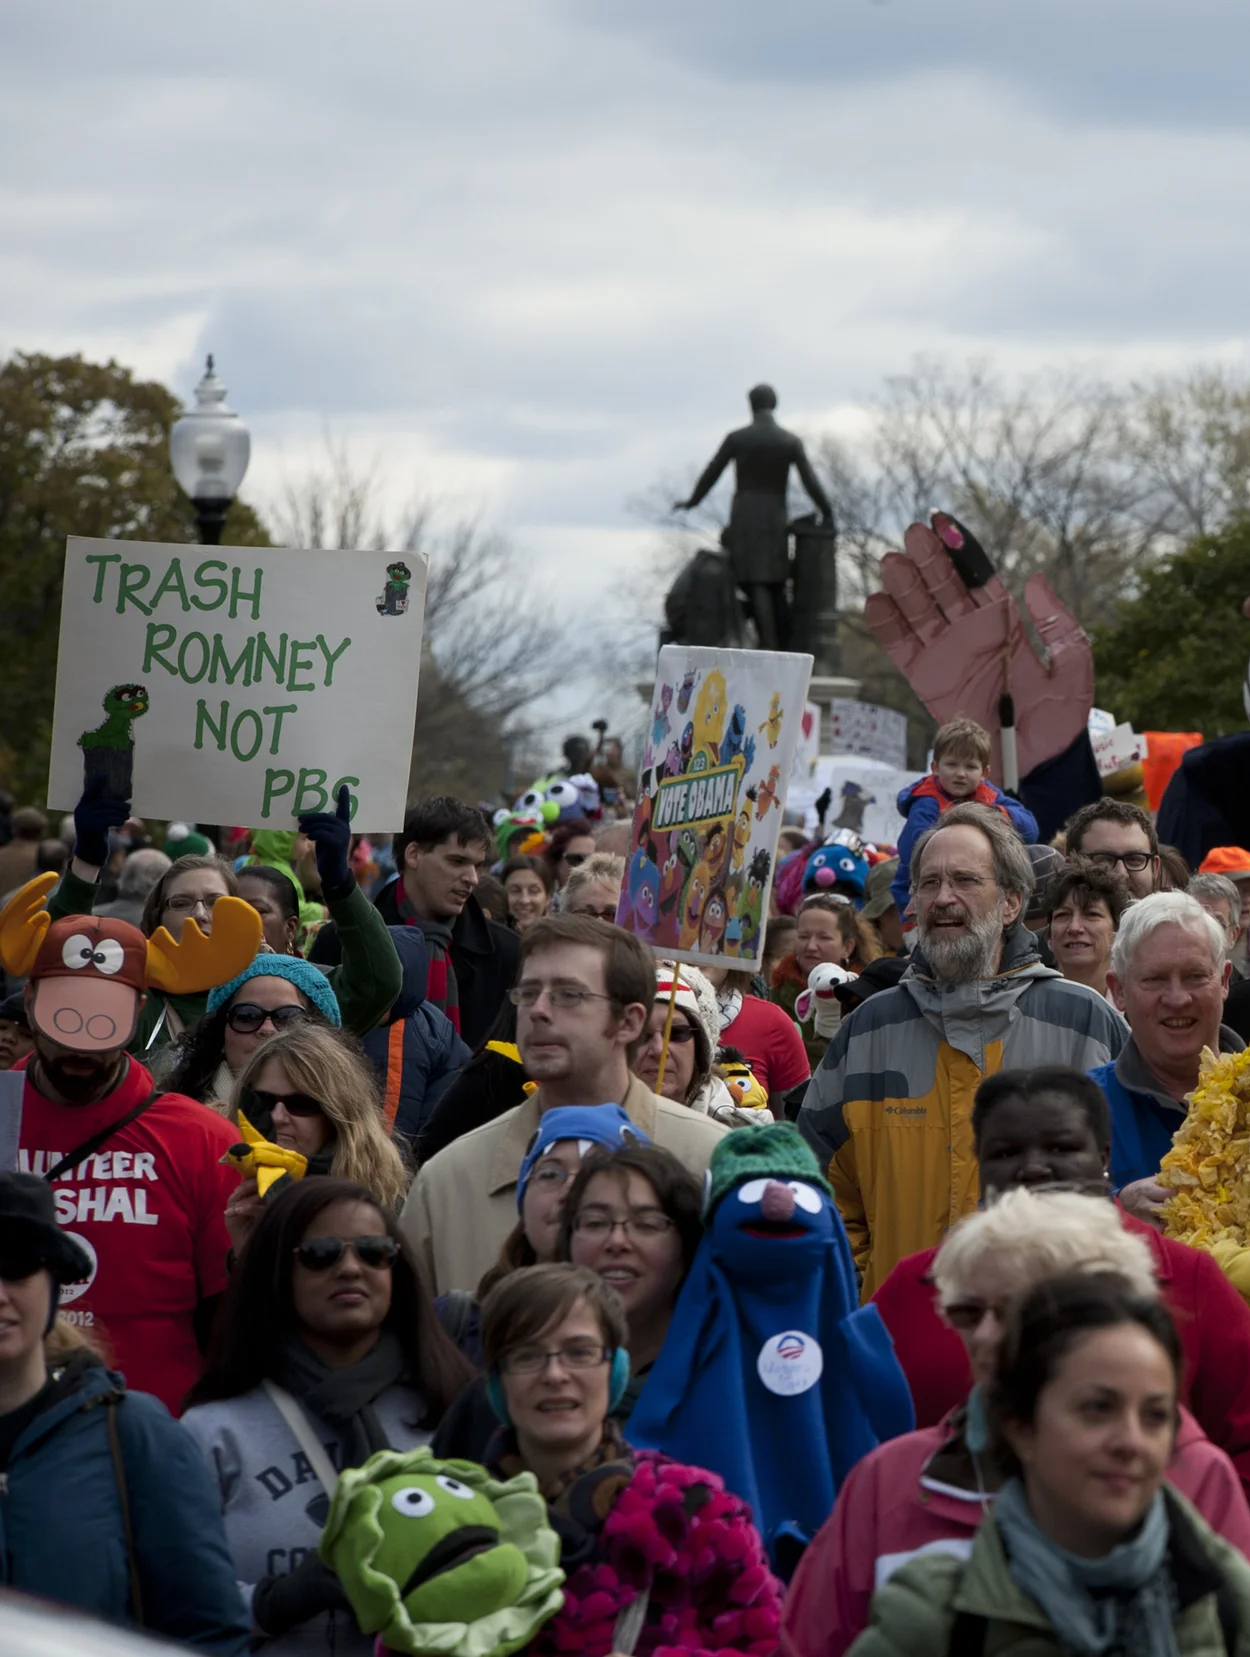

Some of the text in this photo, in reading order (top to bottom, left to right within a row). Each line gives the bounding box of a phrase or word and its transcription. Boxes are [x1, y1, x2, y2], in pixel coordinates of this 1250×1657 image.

[85, 553, 264, 620] TRASH
[141, 622, 352, 692] ROMNEY
[193, 698, 298, 762] NOT
[692, 756, 706, 770] 123
[261, 767, 360, 823] PBS
[657, 773, 736, 827] VOTE OBAMA
[16, 1148, 159, 1182] LUNTEER
[53, 1186, 159, 1225] SHAL
[59, 1288, 74, 1296] 012
